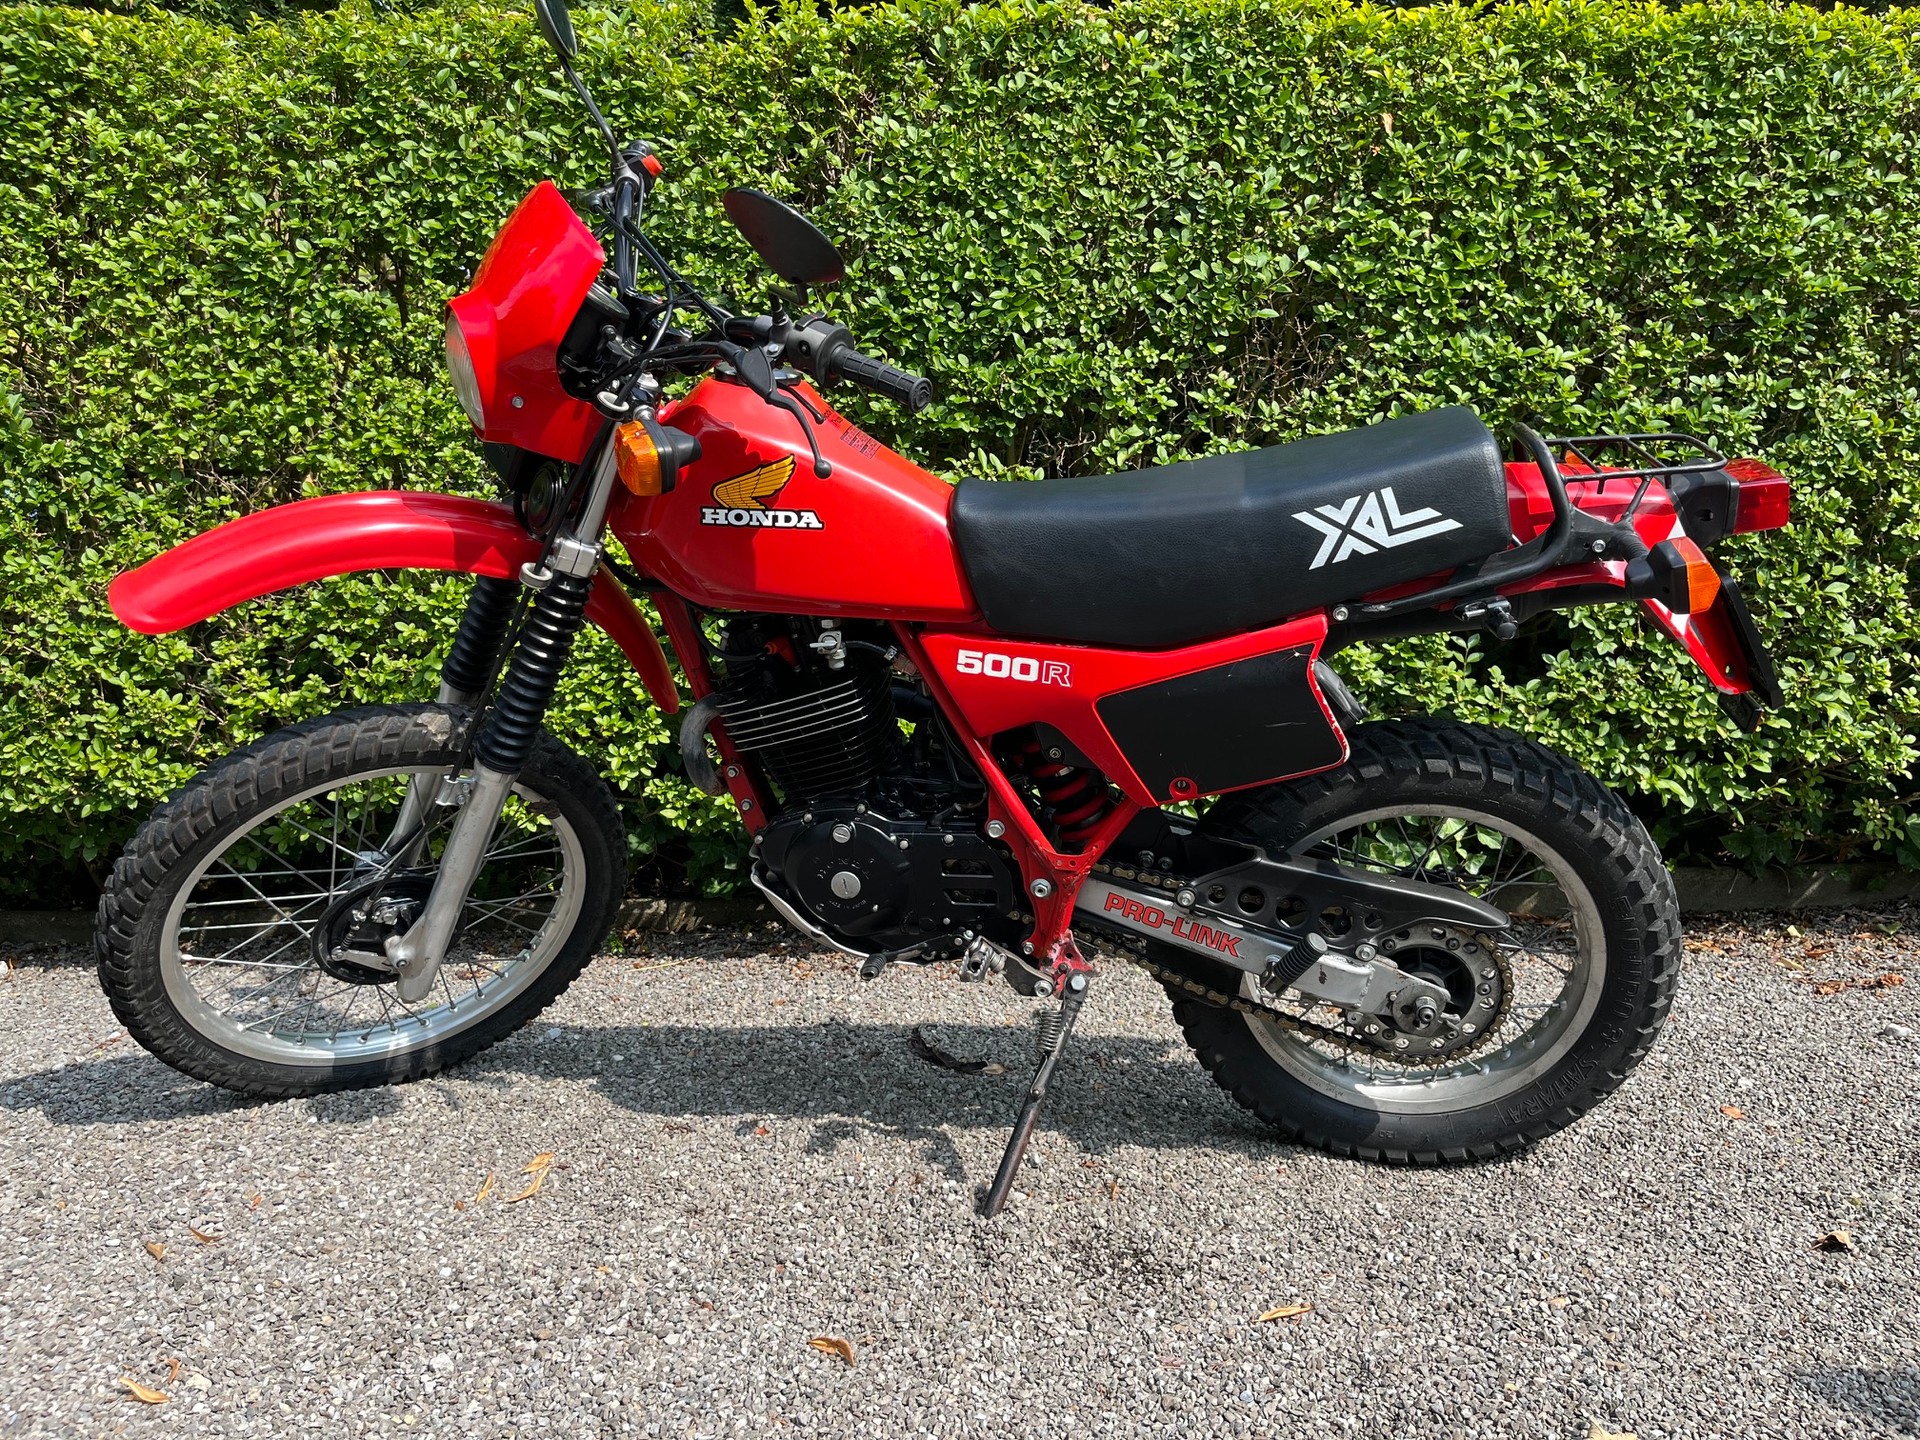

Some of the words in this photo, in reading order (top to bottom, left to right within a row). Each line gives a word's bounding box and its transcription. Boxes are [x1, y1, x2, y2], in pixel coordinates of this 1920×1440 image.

[702, 508, 822, 529] HONDA
[1103, 892, 1243, 958] PRO-LINK
[1507, 1058, 1600, 1124] SAHARA
